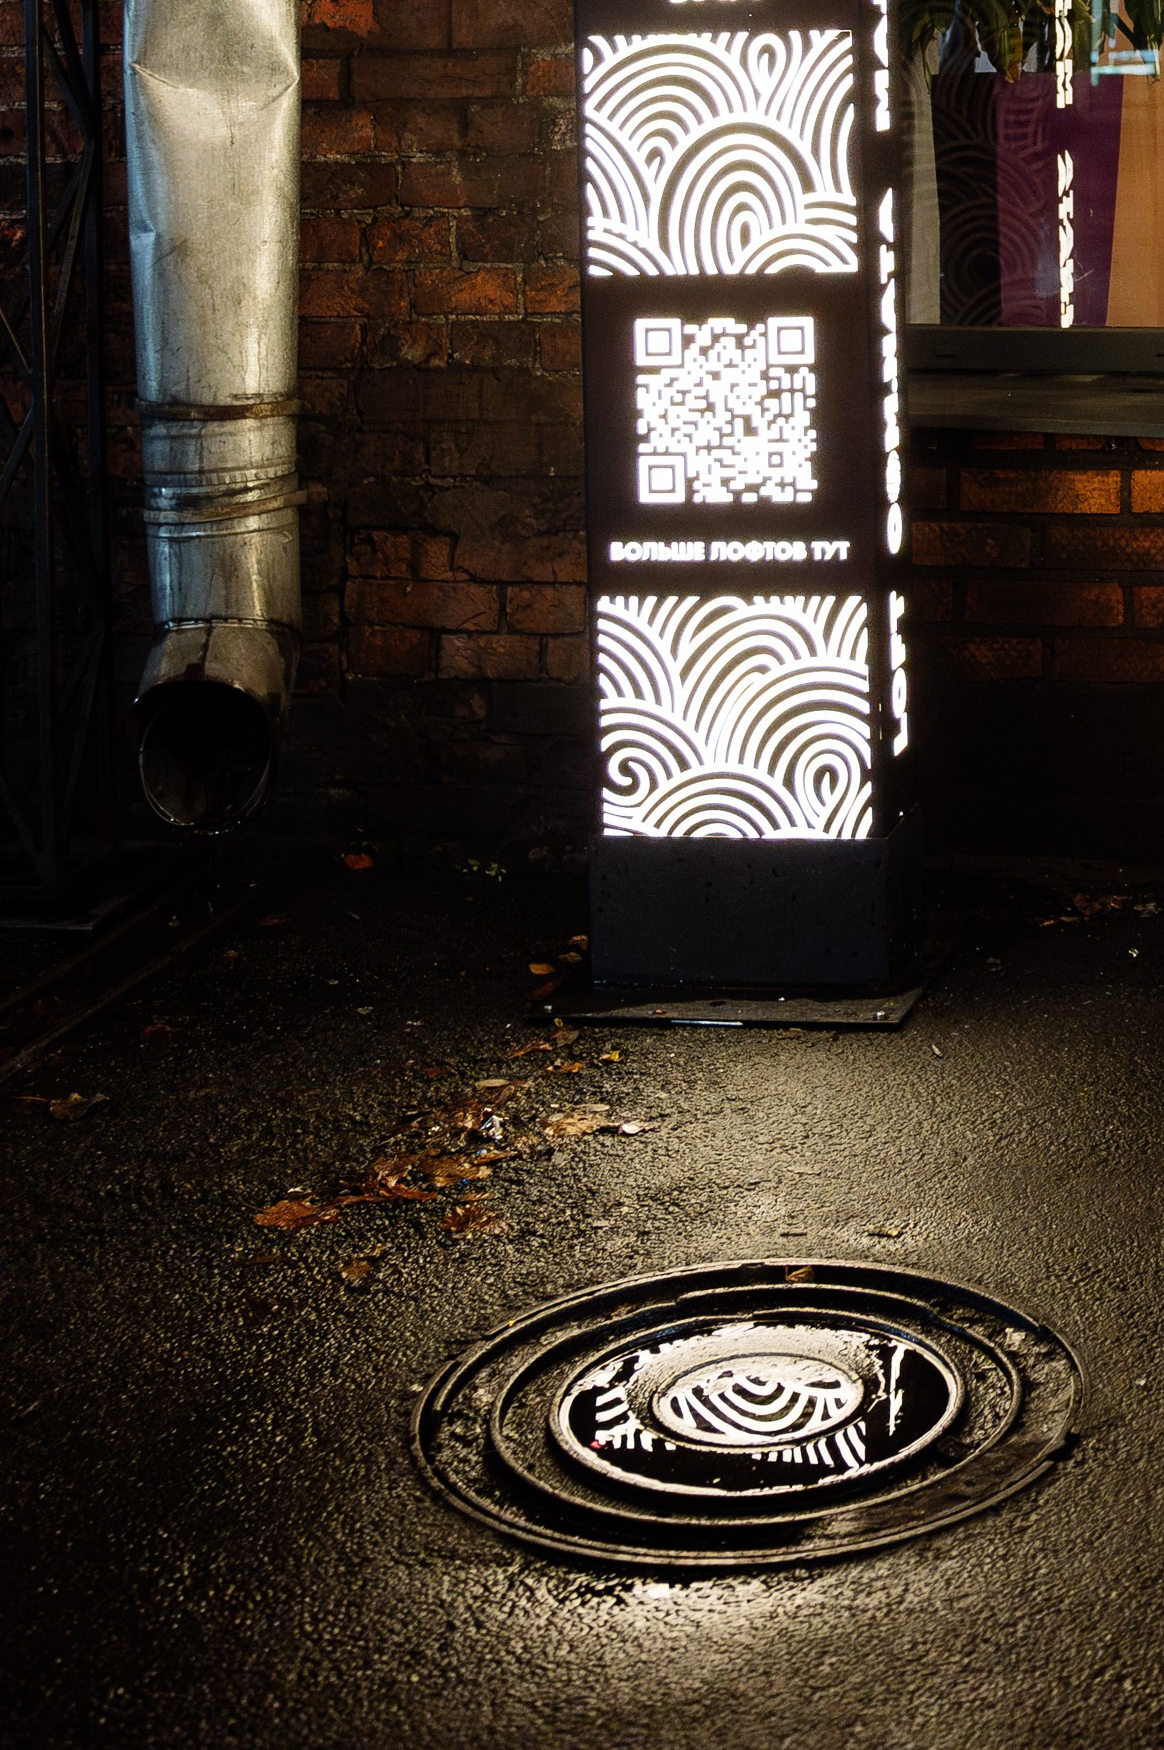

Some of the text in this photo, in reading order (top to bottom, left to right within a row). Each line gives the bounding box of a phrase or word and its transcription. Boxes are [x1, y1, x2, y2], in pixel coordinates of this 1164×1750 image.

[610, 540, 851, 562] БОЛЬШЕ ЛОФТОВ ТУТ
